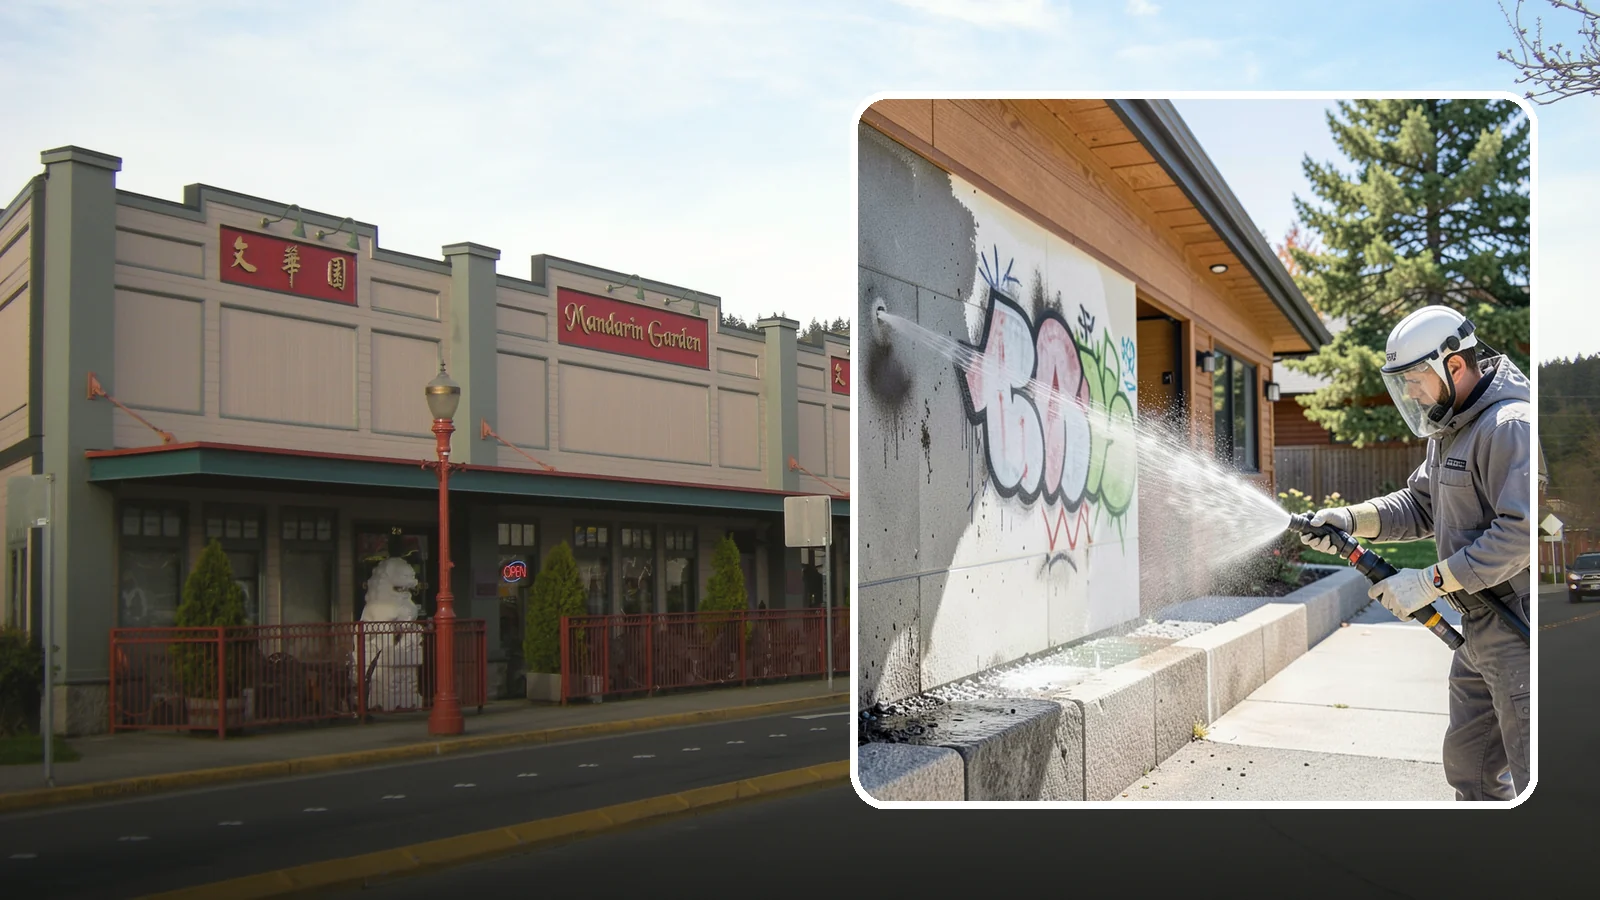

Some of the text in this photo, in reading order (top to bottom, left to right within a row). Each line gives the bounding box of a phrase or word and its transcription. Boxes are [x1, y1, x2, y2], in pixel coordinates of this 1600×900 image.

[231, 235, 346, 291] 文華園
[564, 302, 701, 352] Mandarin Garden
[503, 565, 527, 578] OPEN
